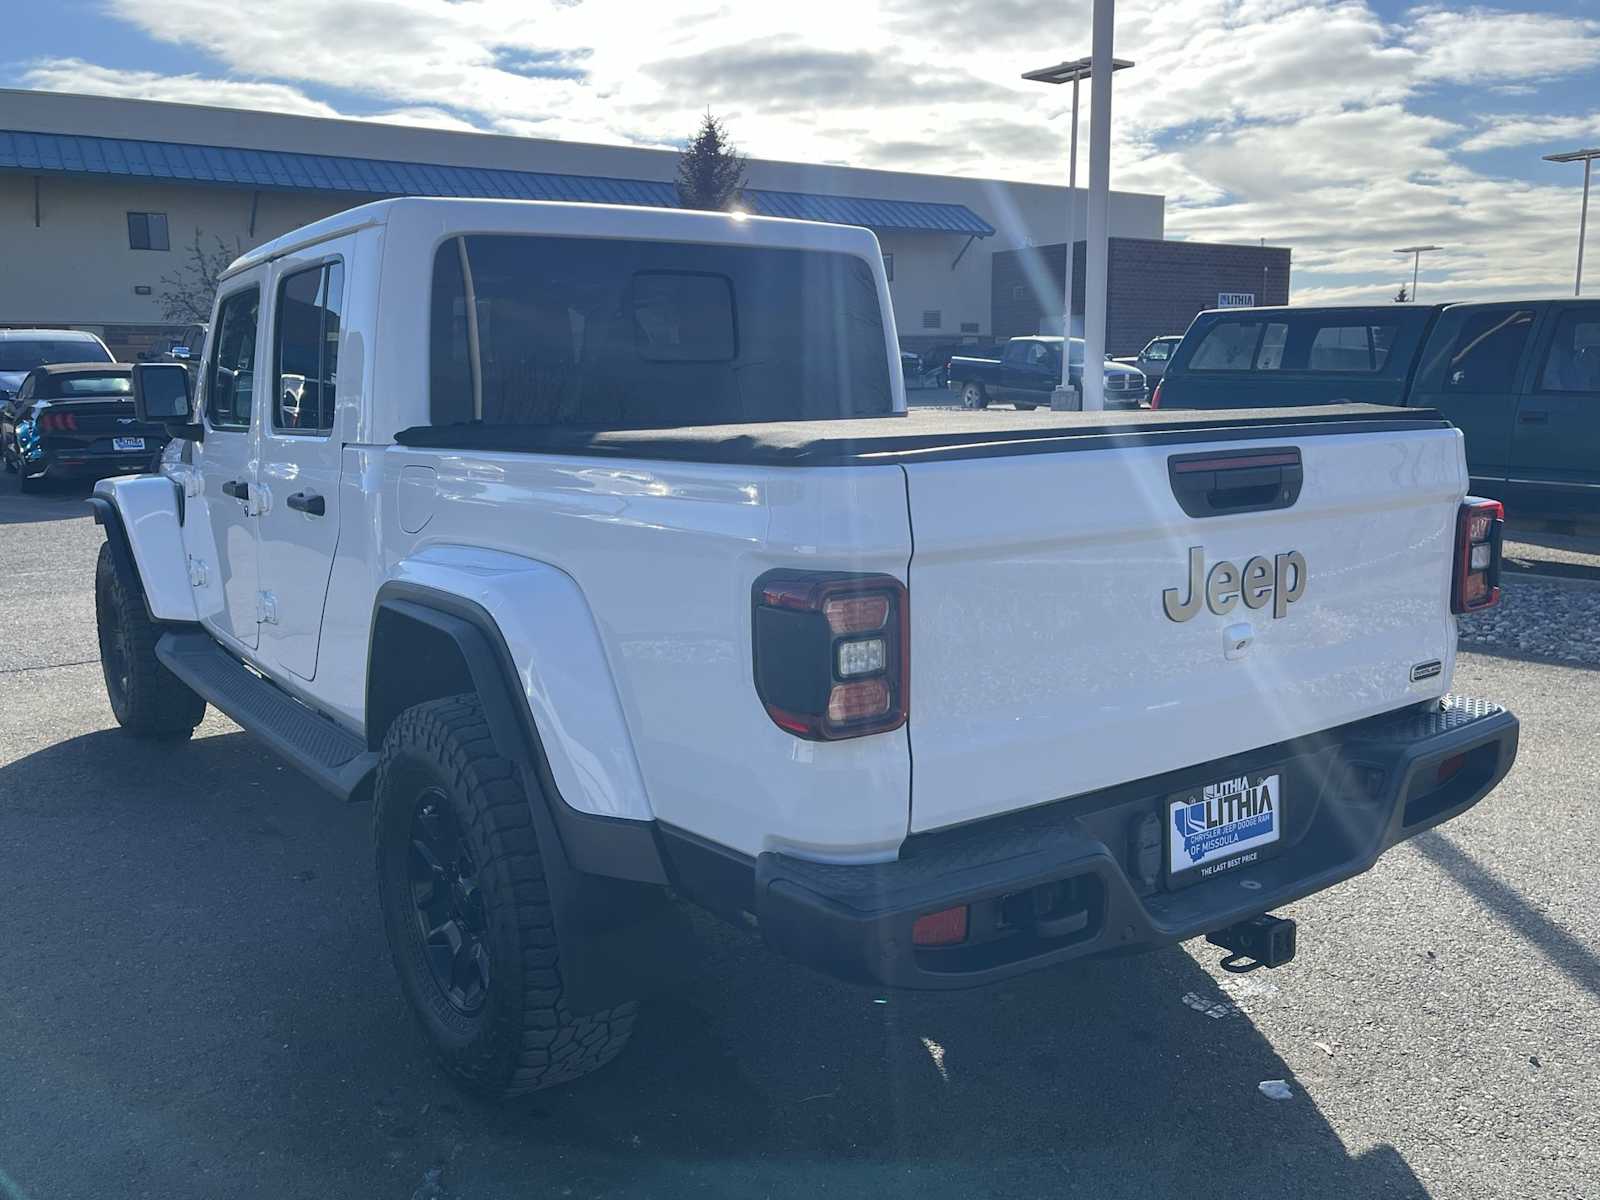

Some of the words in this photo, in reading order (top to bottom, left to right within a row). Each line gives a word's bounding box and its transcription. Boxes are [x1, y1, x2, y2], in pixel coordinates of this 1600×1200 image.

[1227, 295, 1253, 305] LITHIA
[1163, 546, 1307, 619] Jeep
[1214, 776, 1250, 796] LITHIA
[1206, 785, 1273, 828] LITHIA
[1190, 829, 1221, 844] CHRYSLER
[1222, 824, 1237, 835] JEEP
[1238, 819, 1257, 830] DODGE
[1258, 814, 1270, 824] RAM
[1190, 844, 1201, 855] OF
[1202, 834, 1239, 853] MISSOULA
[1201, 866, 1212, 877] THE
[1213, 861, 1227, 873] LAST
[1227, 857, 1241, 869] BEST
[1241, 852, 1258, 864] PRICE
